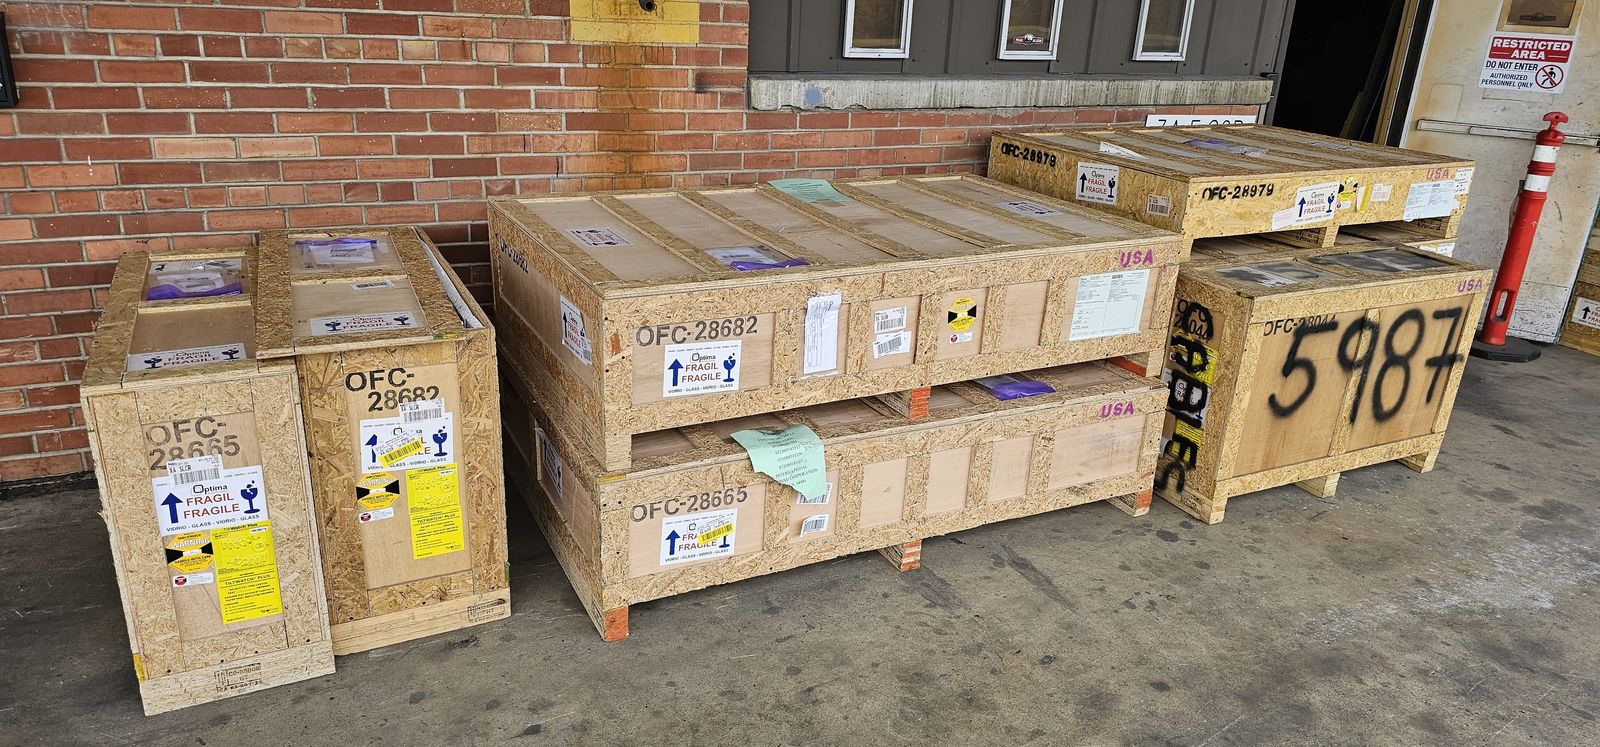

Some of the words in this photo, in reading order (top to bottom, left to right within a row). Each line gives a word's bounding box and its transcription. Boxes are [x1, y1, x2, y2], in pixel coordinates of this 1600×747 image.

[1492, 38, 1571, 52] RESTRICTED
[1510, 49, 1546, 60] AREA
[1485, 60, 1497, 69] DO
[1498, 61, 1513, 70] NOT
[1514, 62, 1539, 71] ENTER
[1480, 79, 1519, 88] PERSONNEL
[1518, 81, 1534, 89] ONLY
[1490, 72, 1528, 81] AUTHORIZED
[1001, 142, 1057, 168] OFC-28979
[1426, 168, 1450, 180] USA
[1087, 178, 1106, 187] FRAGIL
[1085, 186, 1107, 195] FRAGILE
[1202, 183, 1275, 201] OFC-28979
[1303, 205, 1327, 215] FRAGILE
[1306, 199, 1326, 207] FRAGIL
[1120, 248, 1154, 268] USA
[1457, 278, 1485, 293] USA
[635, 315, 758, 347] OFC-28682
[691, 352, 716, 363] Optima
[685, 362, 719, 373] FRAGIL
[1267, 307, 1464, 425] 5987
[345, 367, 415, 392] OFC-
[681, 372, 721, 384] FRAGILE
[368, 385, 440, 412] 28682
[1101, 401, 1134, 418] USA
[145, 416, 227, 447] OFC-
[149, 434, 241, 470] 28665
[192, 484, 228, 495] Optima
[186, 492, 234, 507] FRAGIL
[629, 486, 748, 522] OFC-28665
[183, 503, 241, 519] FRAGILE
[166, 524, 187, 532] VIDRIO
[191, 521, 212, 529] GLASS
[215, 517, 236, 525] VIDRIO
[240, 514, 260, 522] GLASS
